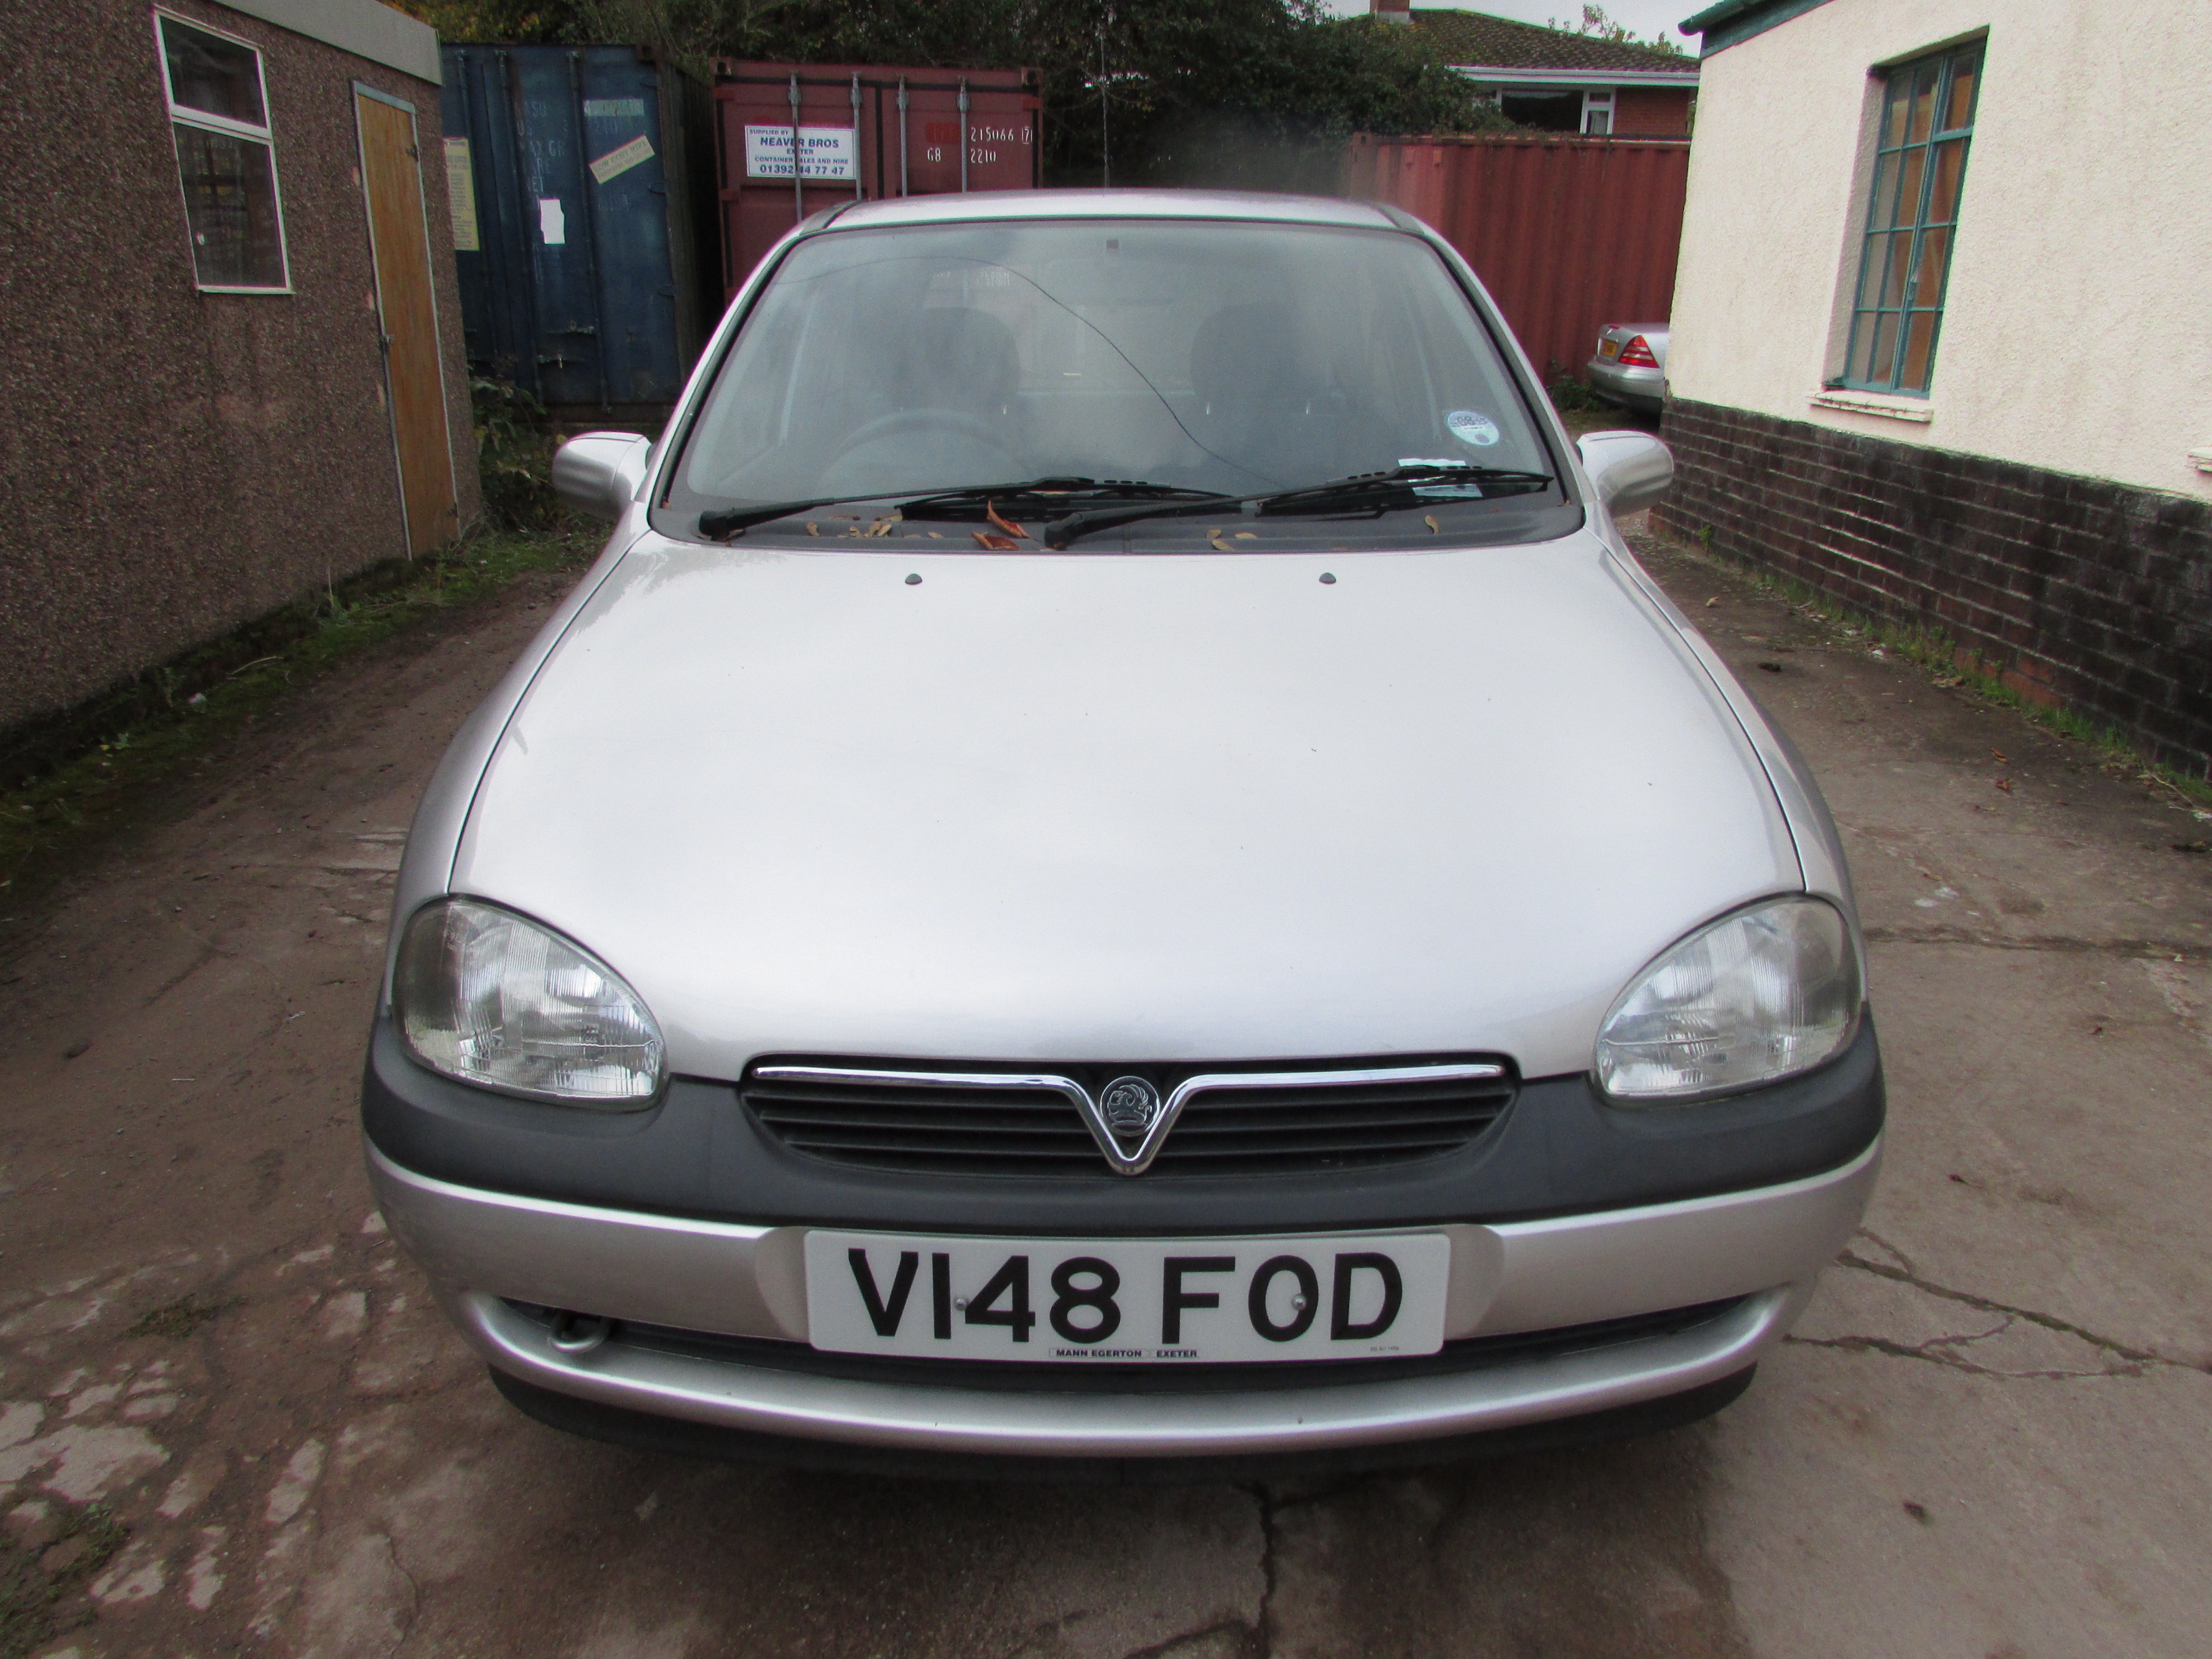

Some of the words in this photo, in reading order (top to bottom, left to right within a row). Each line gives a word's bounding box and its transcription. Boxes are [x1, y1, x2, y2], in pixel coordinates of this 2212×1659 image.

[970, 127, 1014, 142] 215066
[808, 138, 839, 148] BROS
[970, 148, 996, 163] 2210
[760, 165, 794, 174] 01392
[816, 166, 827, 175] 77
[832, 167, 845, 176] 47
[848, 1248, 1121, 1345] V148
[1162, 1252, 1403, 1344] FOD
[1056, 1349, 1088, 1357] MANN
[1091, 1349, 1142, 1357] EGERTON
[1156, 1349, 1197, 1357] EXETER
